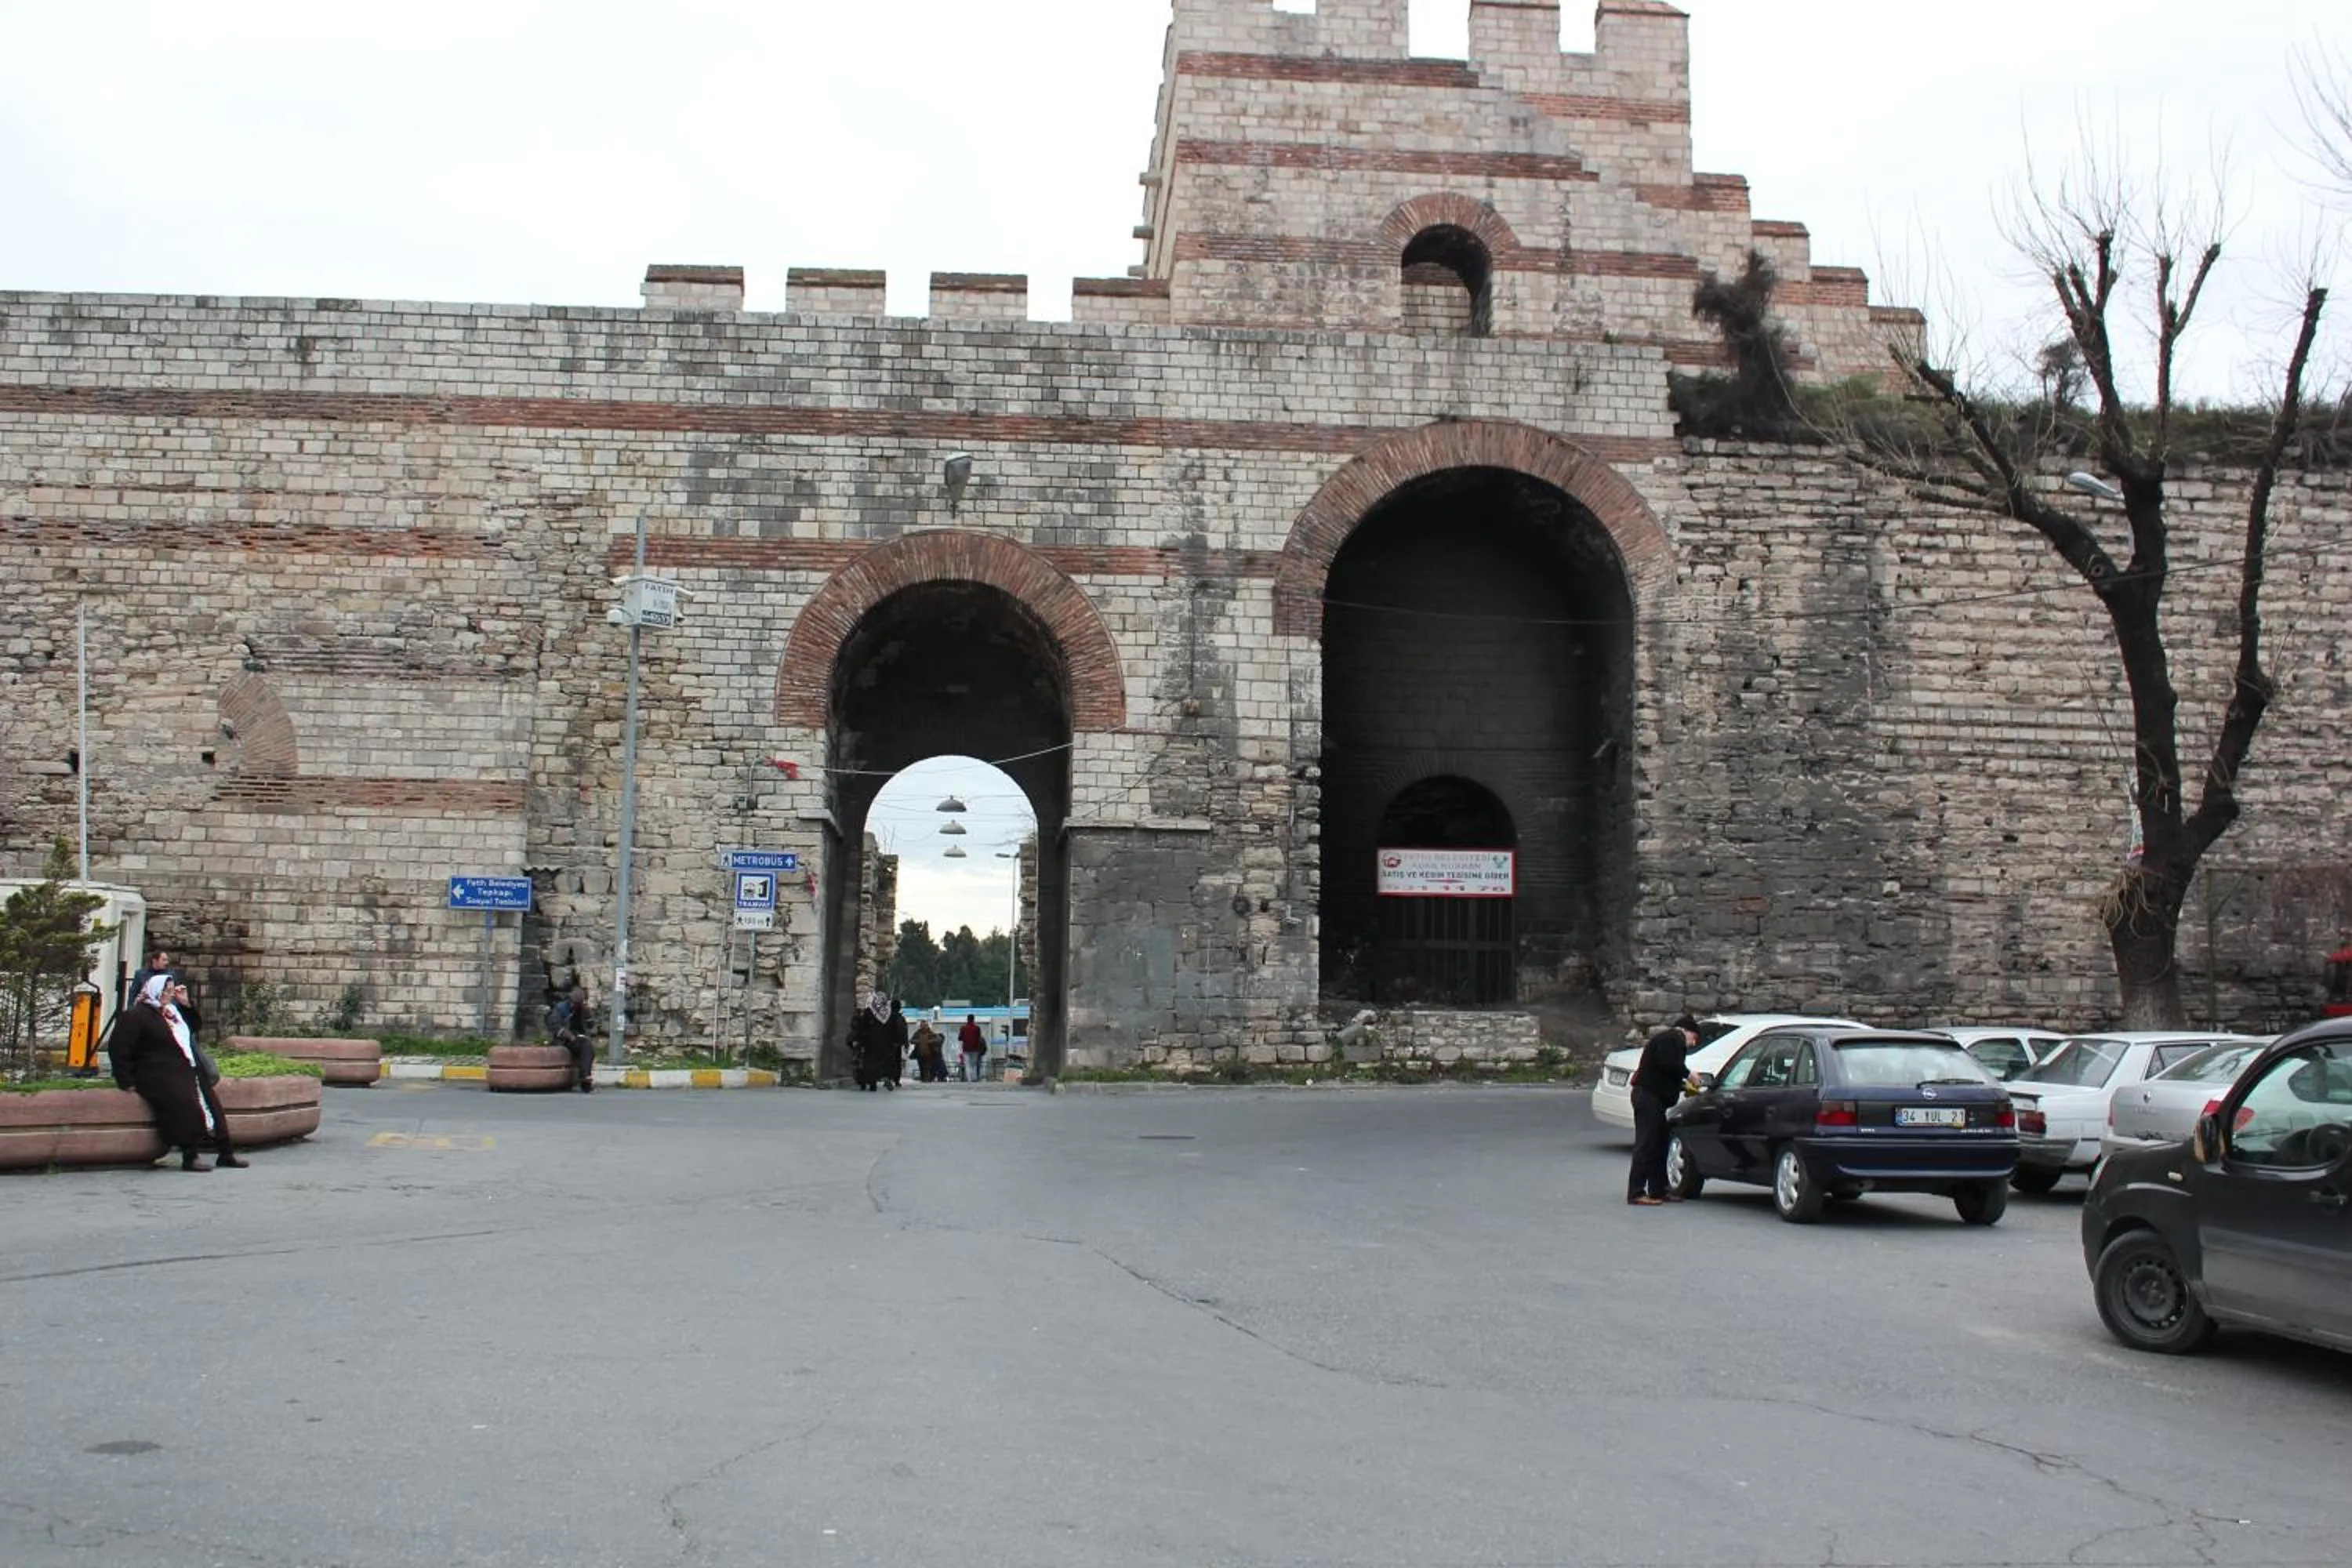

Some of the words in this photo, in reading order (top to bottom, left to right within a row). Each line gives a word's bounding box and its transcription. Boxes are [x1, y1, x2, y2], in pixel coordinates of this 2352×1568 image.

[733, 854, 783, 866] METROBÜS
[1903, 1109, 1915, 1122] 34
[1951, 1110, 1964, 1123] 21
